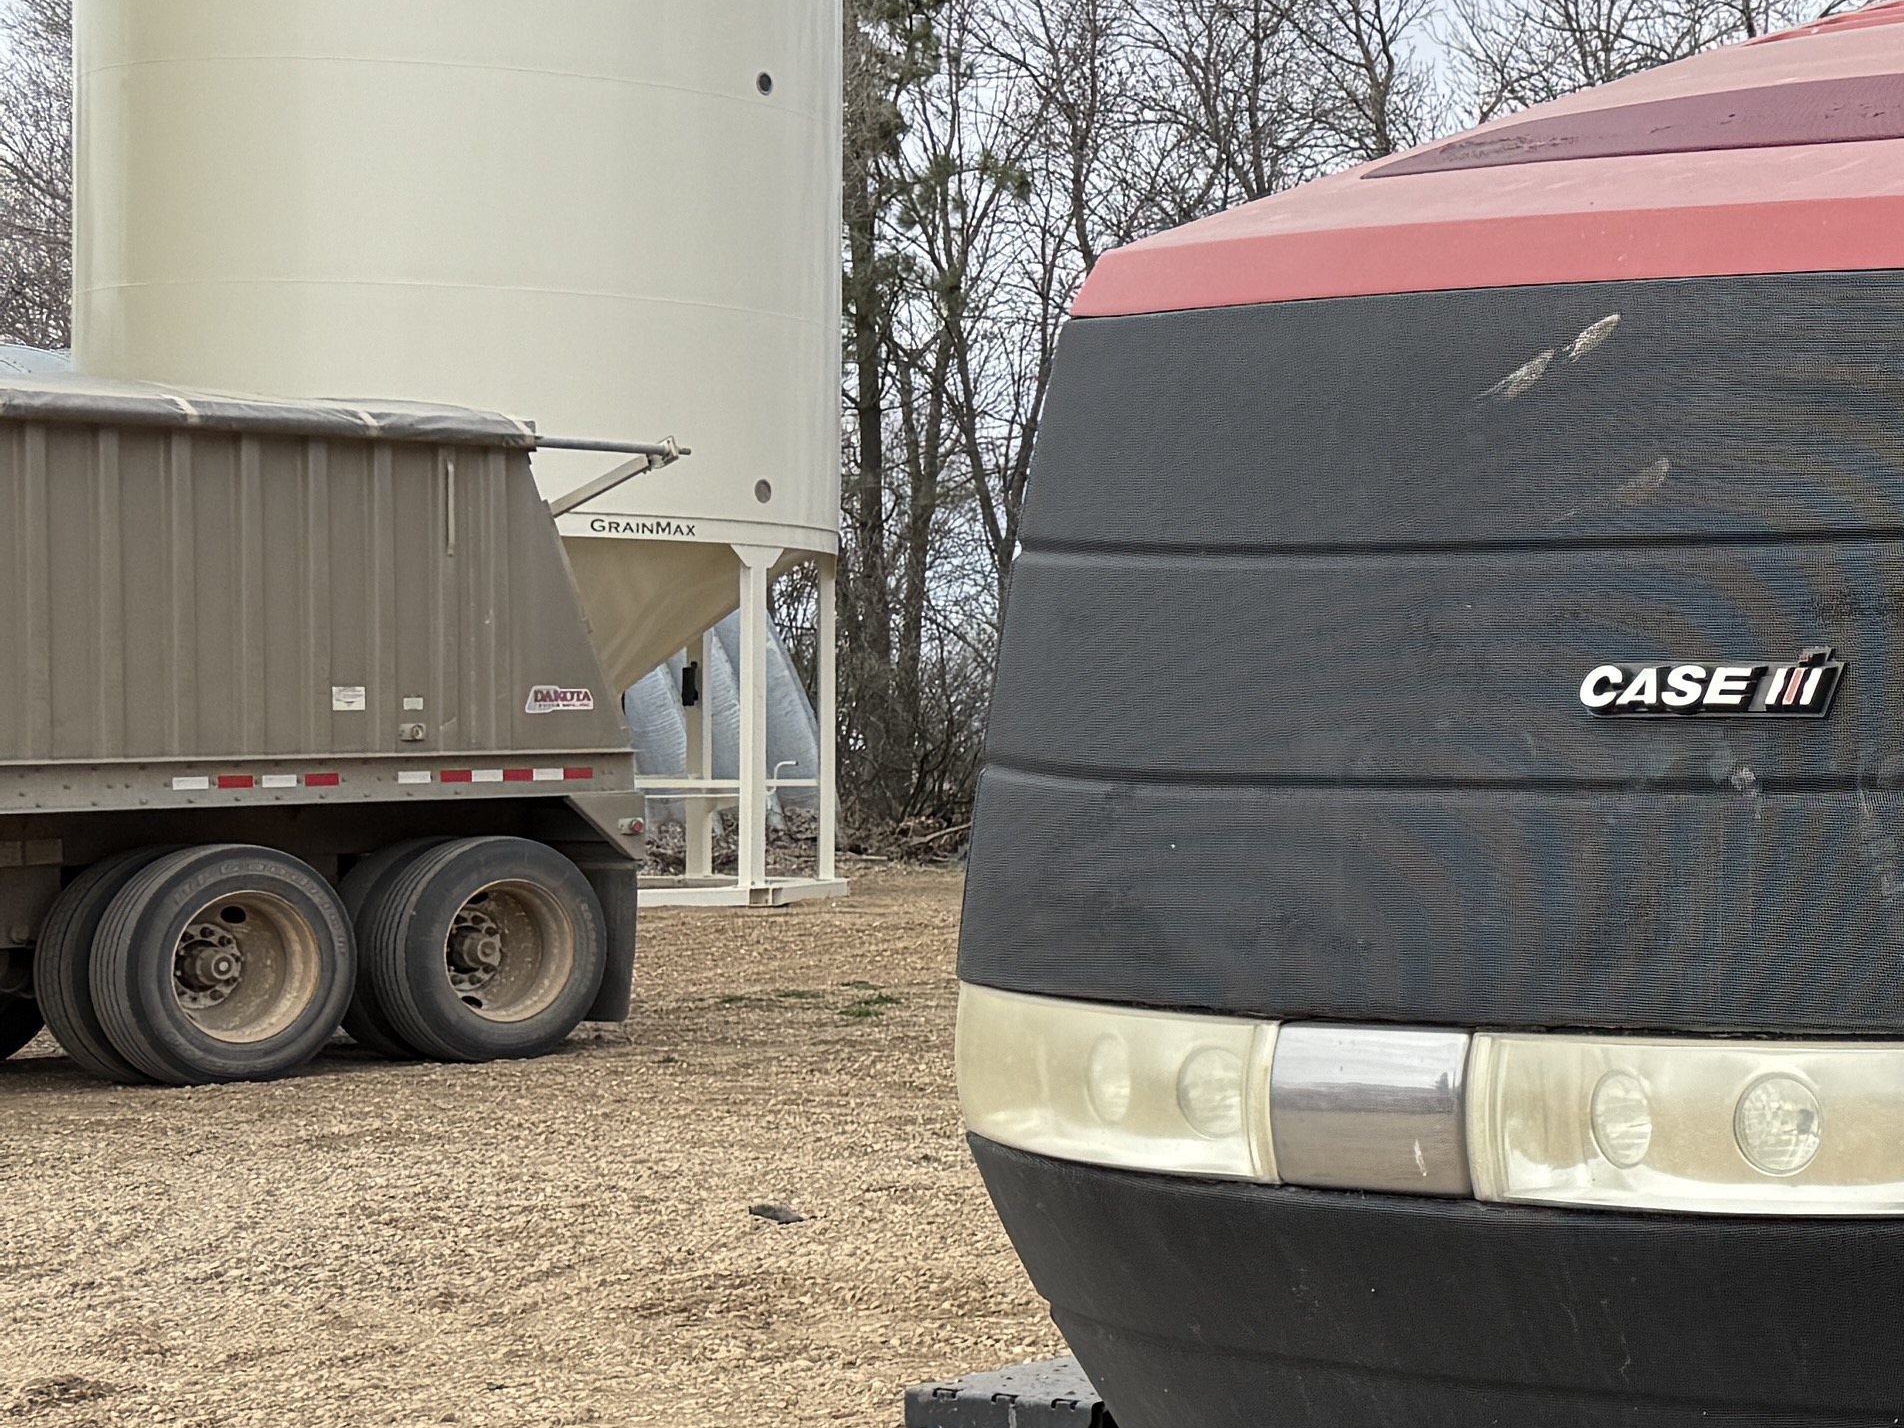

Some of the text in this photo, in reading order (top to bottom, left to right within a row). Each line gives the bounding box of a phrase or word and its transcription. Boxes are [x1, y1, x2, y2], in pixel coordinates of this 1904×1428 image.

[590, 518, 696, 536] GRAINMAX
[1579, 665, 1753, 708] CASE
[534, 690, 591, 702] DAKOTA
